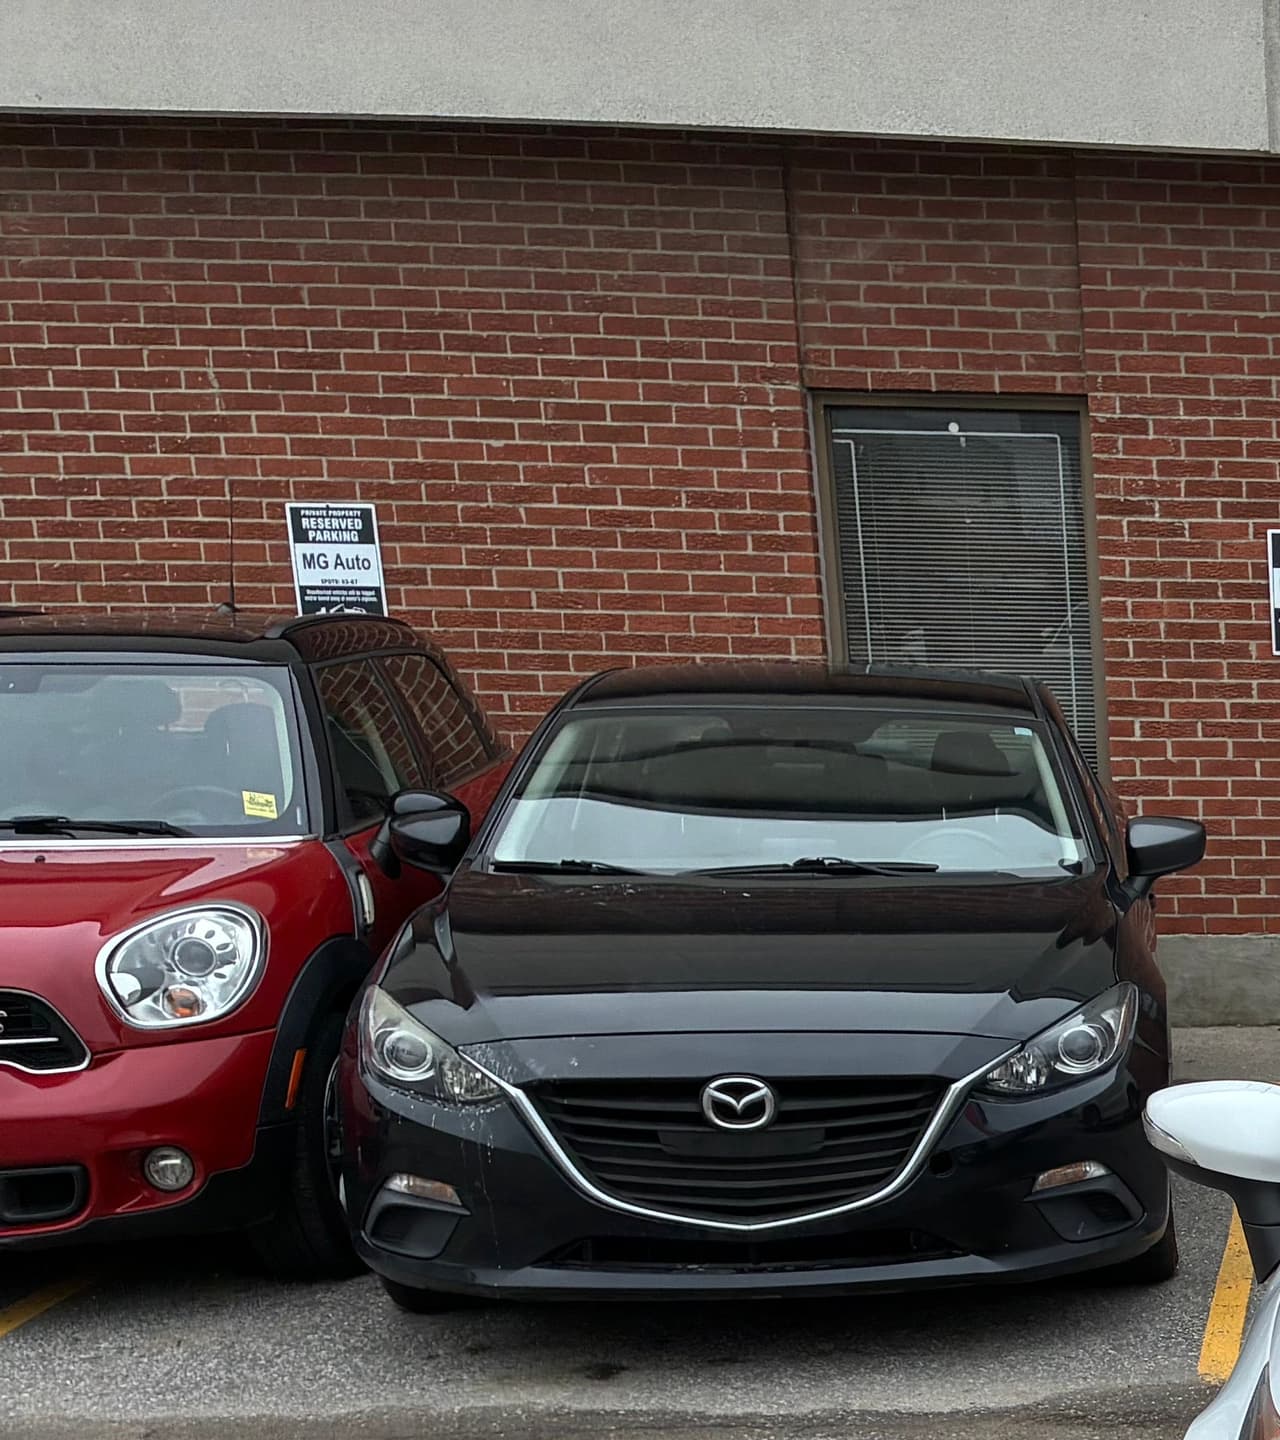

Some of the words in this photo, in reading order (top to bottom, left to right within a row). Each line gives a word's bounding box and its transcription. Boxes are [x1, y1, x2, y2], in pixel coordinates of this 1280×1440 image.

[301, 517, 363, 530] RESERVED
[308, 530, 359, 542] PARKING
[302, 552, 329, 570] MG
[334, 553, 371, 570] Auto
